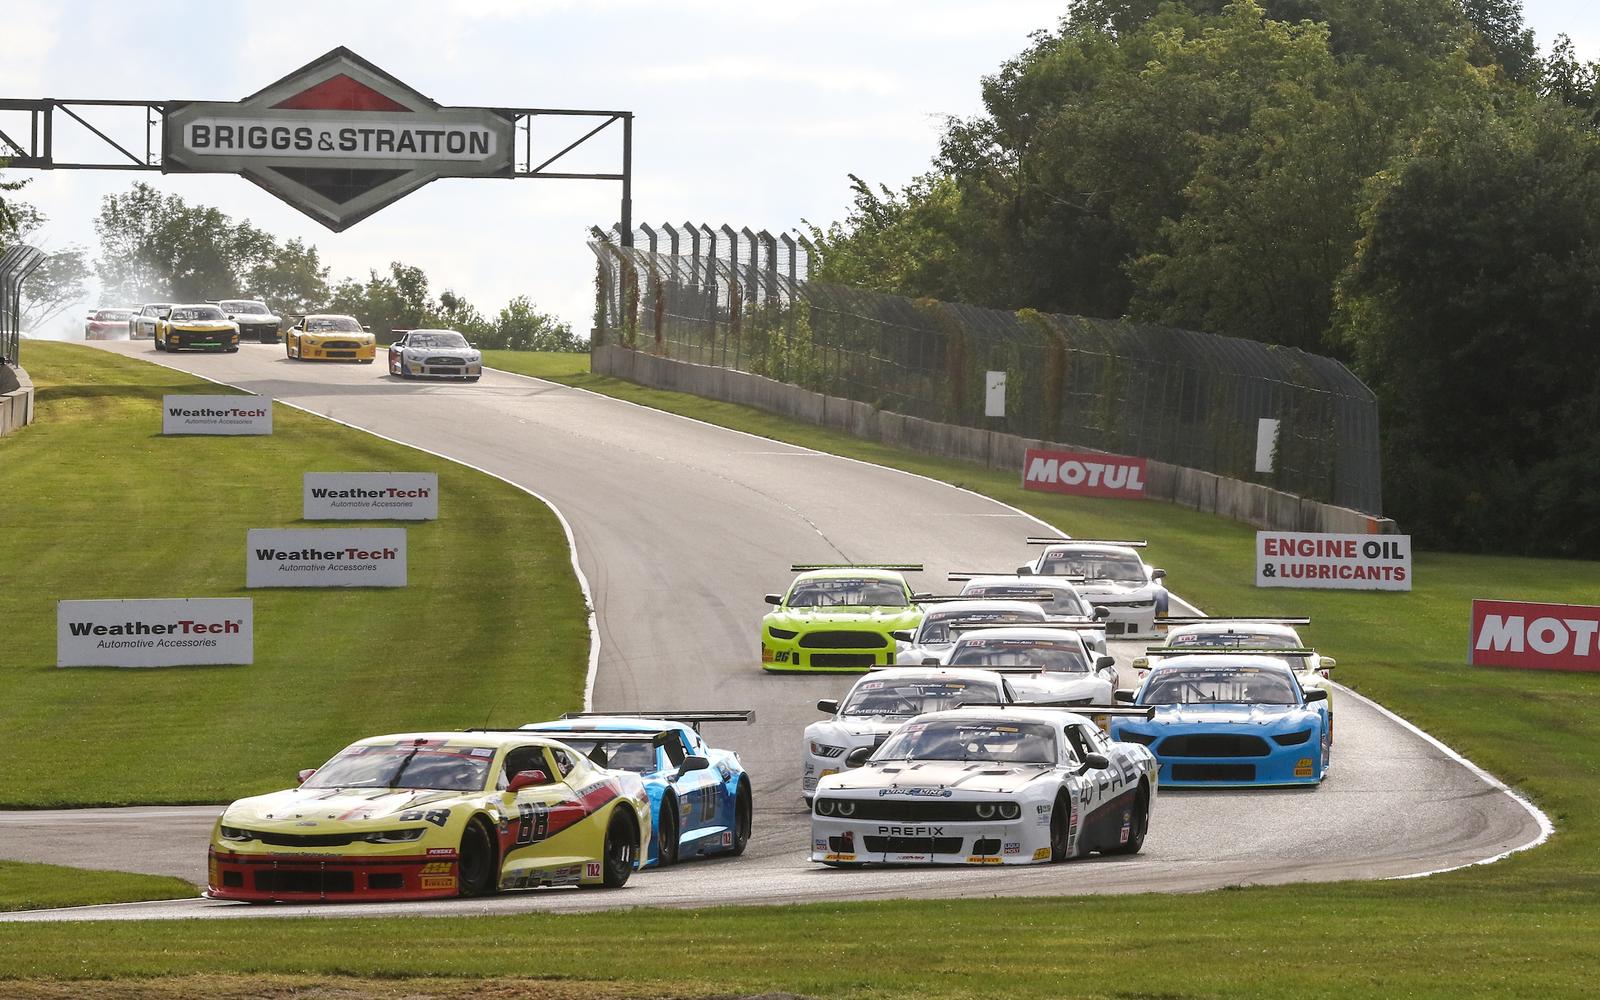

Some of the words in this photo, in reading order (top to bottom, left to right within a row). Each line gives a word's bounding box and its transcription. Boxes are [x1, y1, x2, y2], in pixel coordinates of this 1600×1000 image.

[191, 124, 313, 151] BRIGGS
[338, 128, 489, 155] STRATTON
[1026, 457, 1145, 491] MOTUL
[330, 500, 371, 509] Automotive
[371, 500, 413, 508] Accessories
[1263, 537, 1358, 559] ENGINE
[1362, 540, 1404, 561] OIL
[278, 563, 326, 573] Automotive
[327, 563, 378, 572] Accessories
[1262, 563, 1277, 578] &
[1279, 563, 1406, 582] LUBRICANTS
[96, 639, 155, 650] Automotive
[156, 637, 218, 649] Accessories
[1475, 613, 1600, 657] MOT
[516, 801, 549, 844] 88
[878, 826, 944, 836] PREFIX
[587, 863, 600, 877] TA2
